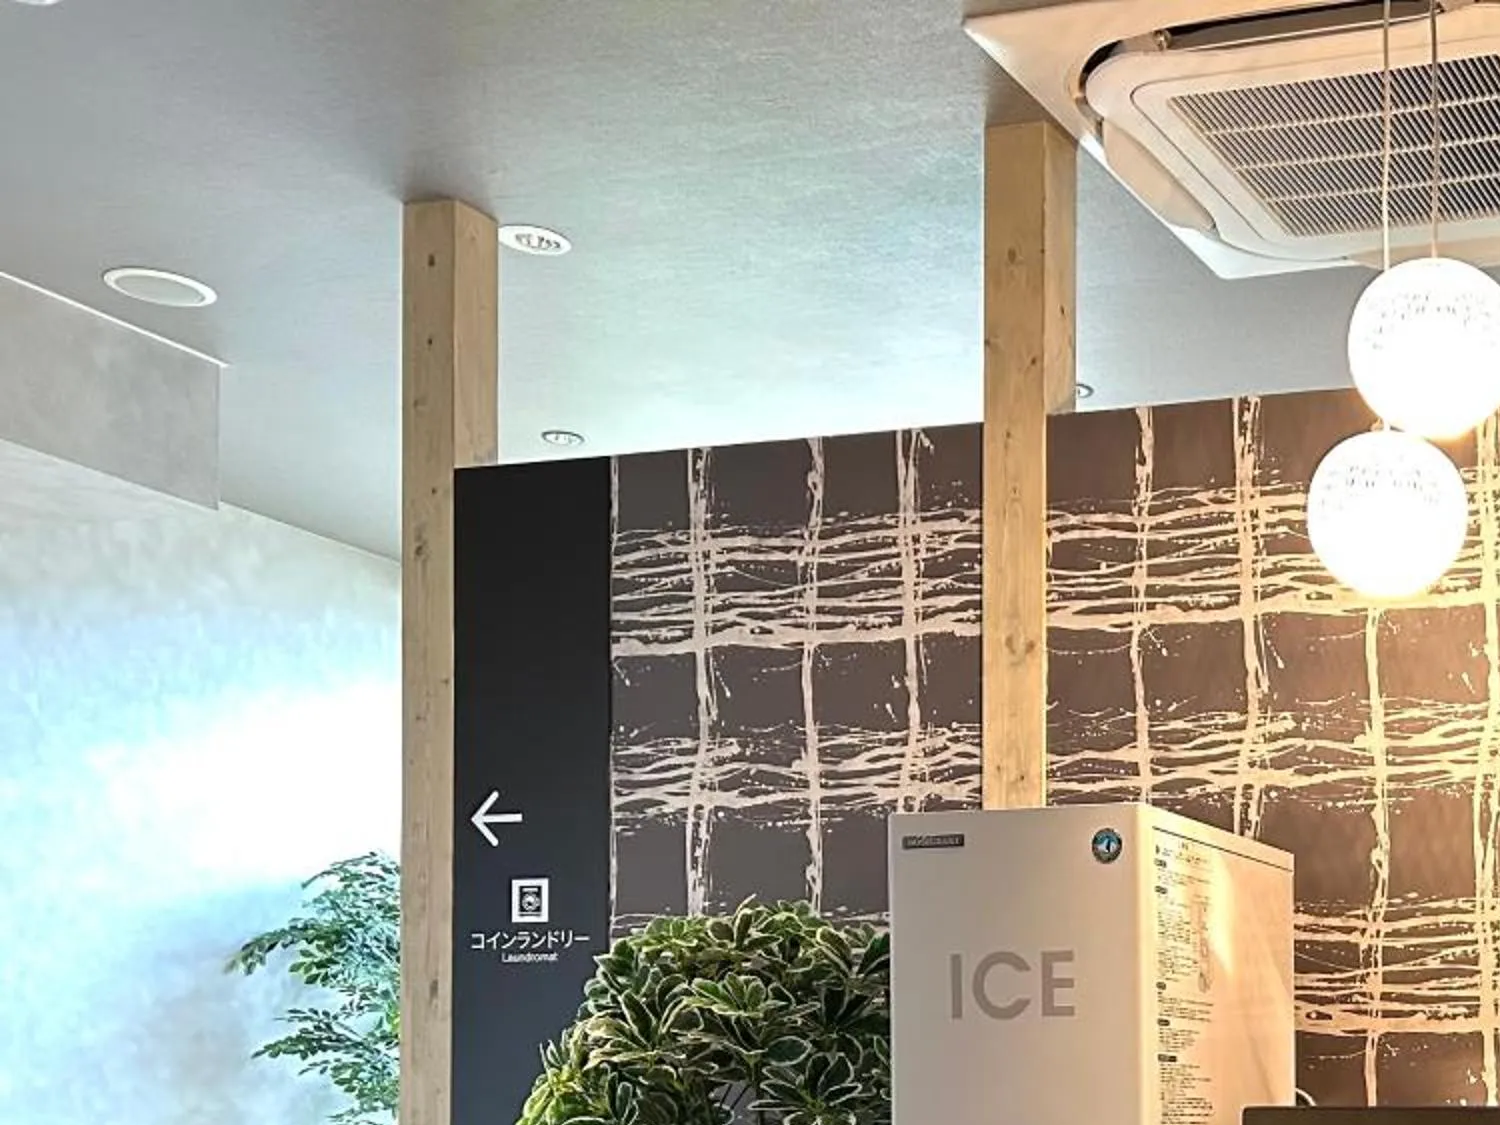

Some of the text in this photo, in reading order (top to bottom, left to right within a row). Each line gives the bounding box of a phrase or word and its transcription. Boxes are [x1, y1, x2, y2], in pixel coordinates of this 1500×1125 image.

[471, 930, 590, 949] コインランドリー
[501, 952, 558, 963] Laundromat
[950, 950, 1075, 1019] ICE
